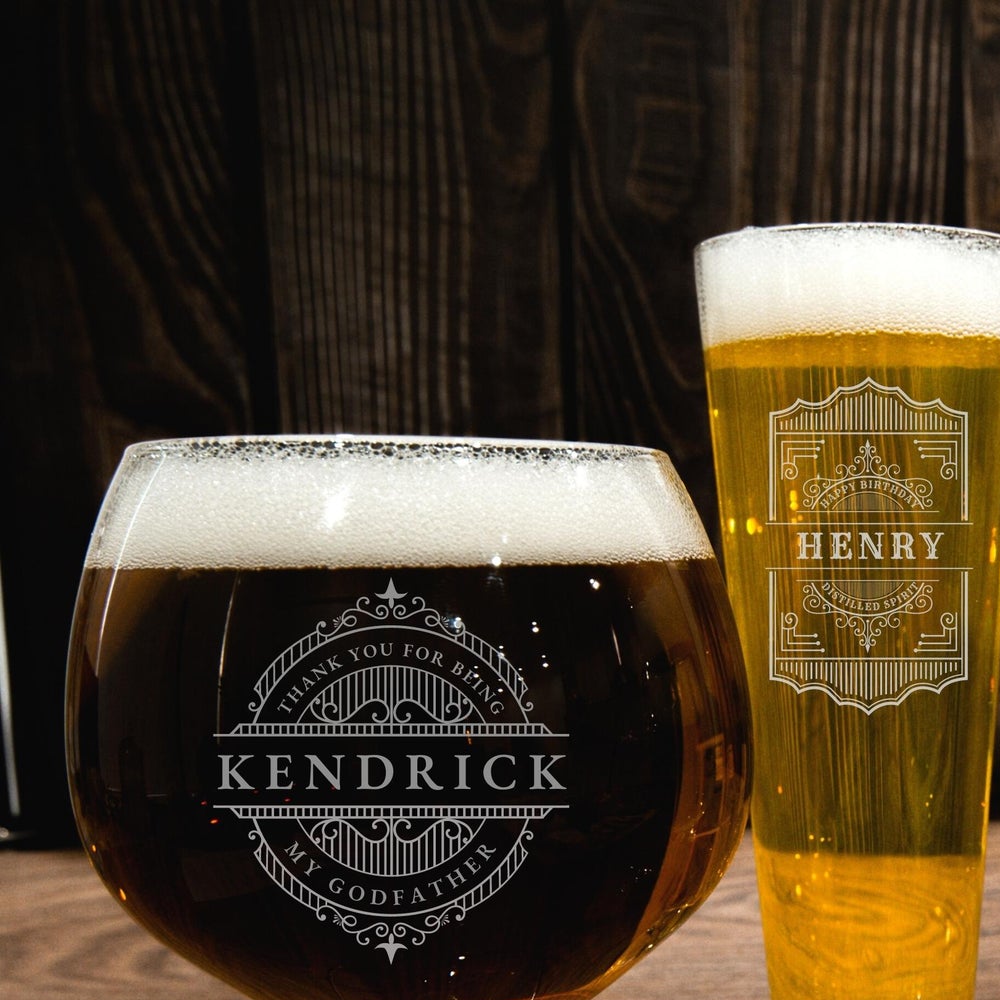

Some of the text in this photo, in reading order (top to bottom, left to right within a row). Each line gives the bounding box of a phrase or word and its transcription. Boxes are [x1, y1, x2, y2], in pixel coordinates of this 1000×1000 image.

[820, 480, 921, 509] HAPPY BIRTHDAY
[796, 532, 945, 560] HENRY
[822, 581, 919, 611] DISTILLED SPIRIT
[277, 642, 504, 716] THANK YOU FOR BEING
[217, 754, 567, 790] KENDRICK
[284, 840, 497, 906] MY GODFATHER
